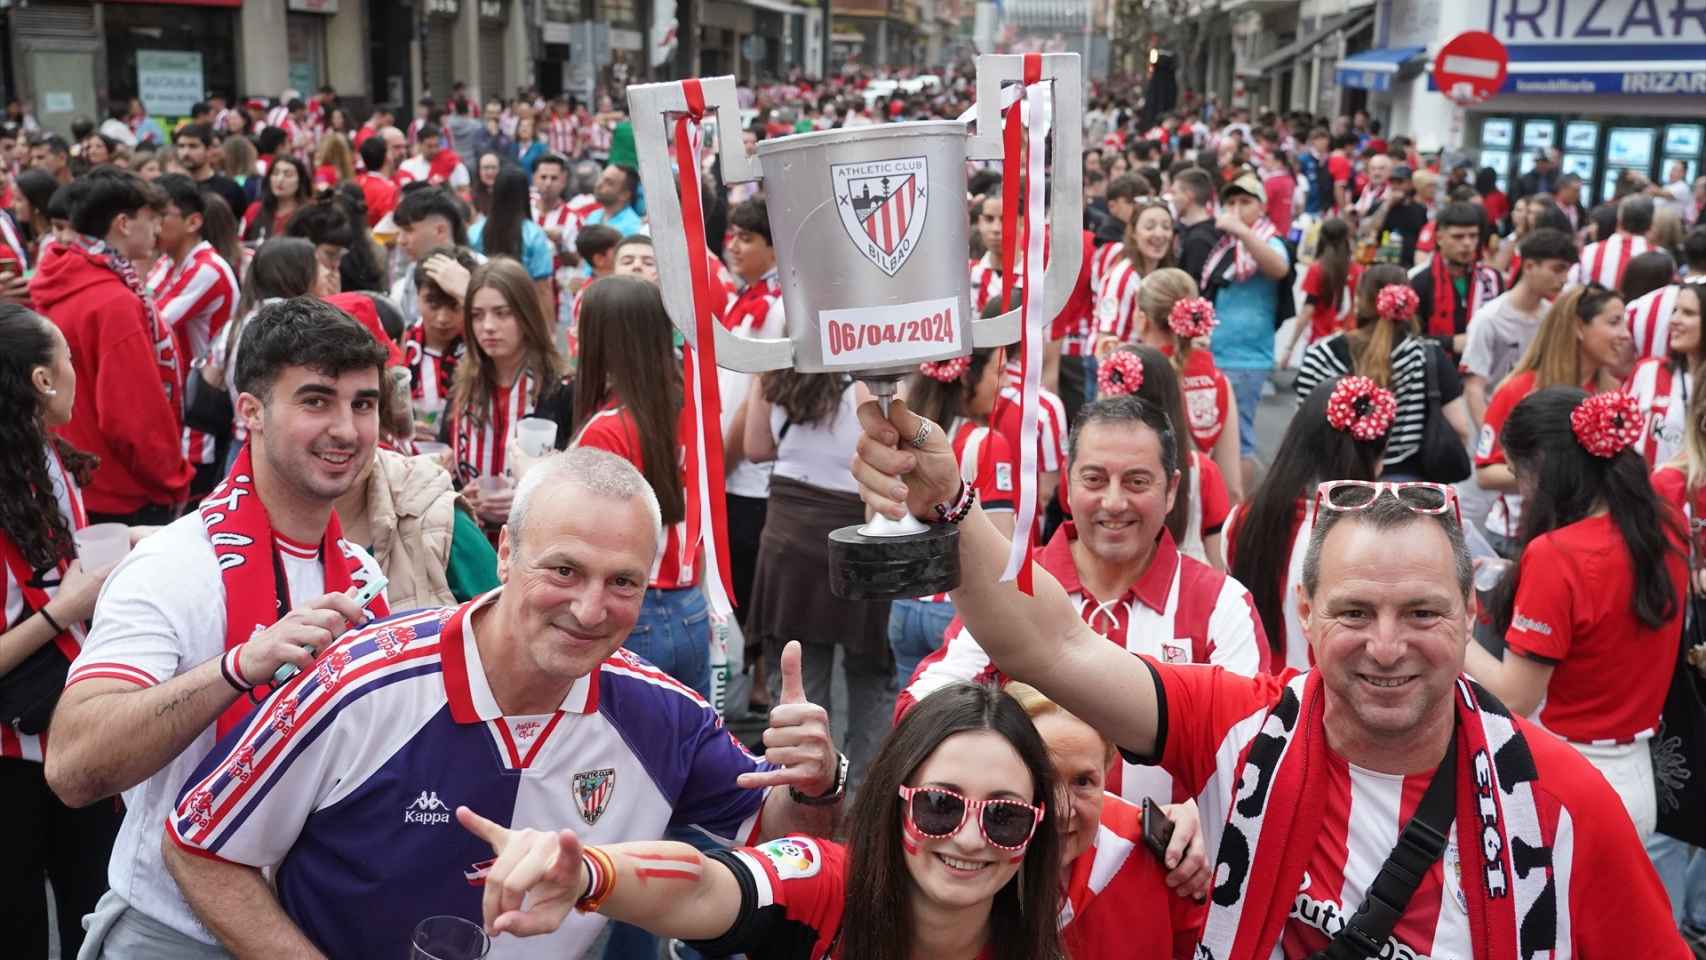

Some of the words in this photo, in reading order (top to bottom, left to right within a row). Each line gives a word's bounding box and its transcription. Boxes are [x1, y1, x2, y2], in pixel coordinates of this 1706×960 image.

[838, 163, 892, 176] ATHLETIC
[895, 160, 922, 171] CLUB
[868, 238, 911, 271] BILBAO
[828, 308, 954, 356] 06/04/2024
[405, 810, 450, 825] Kappa
